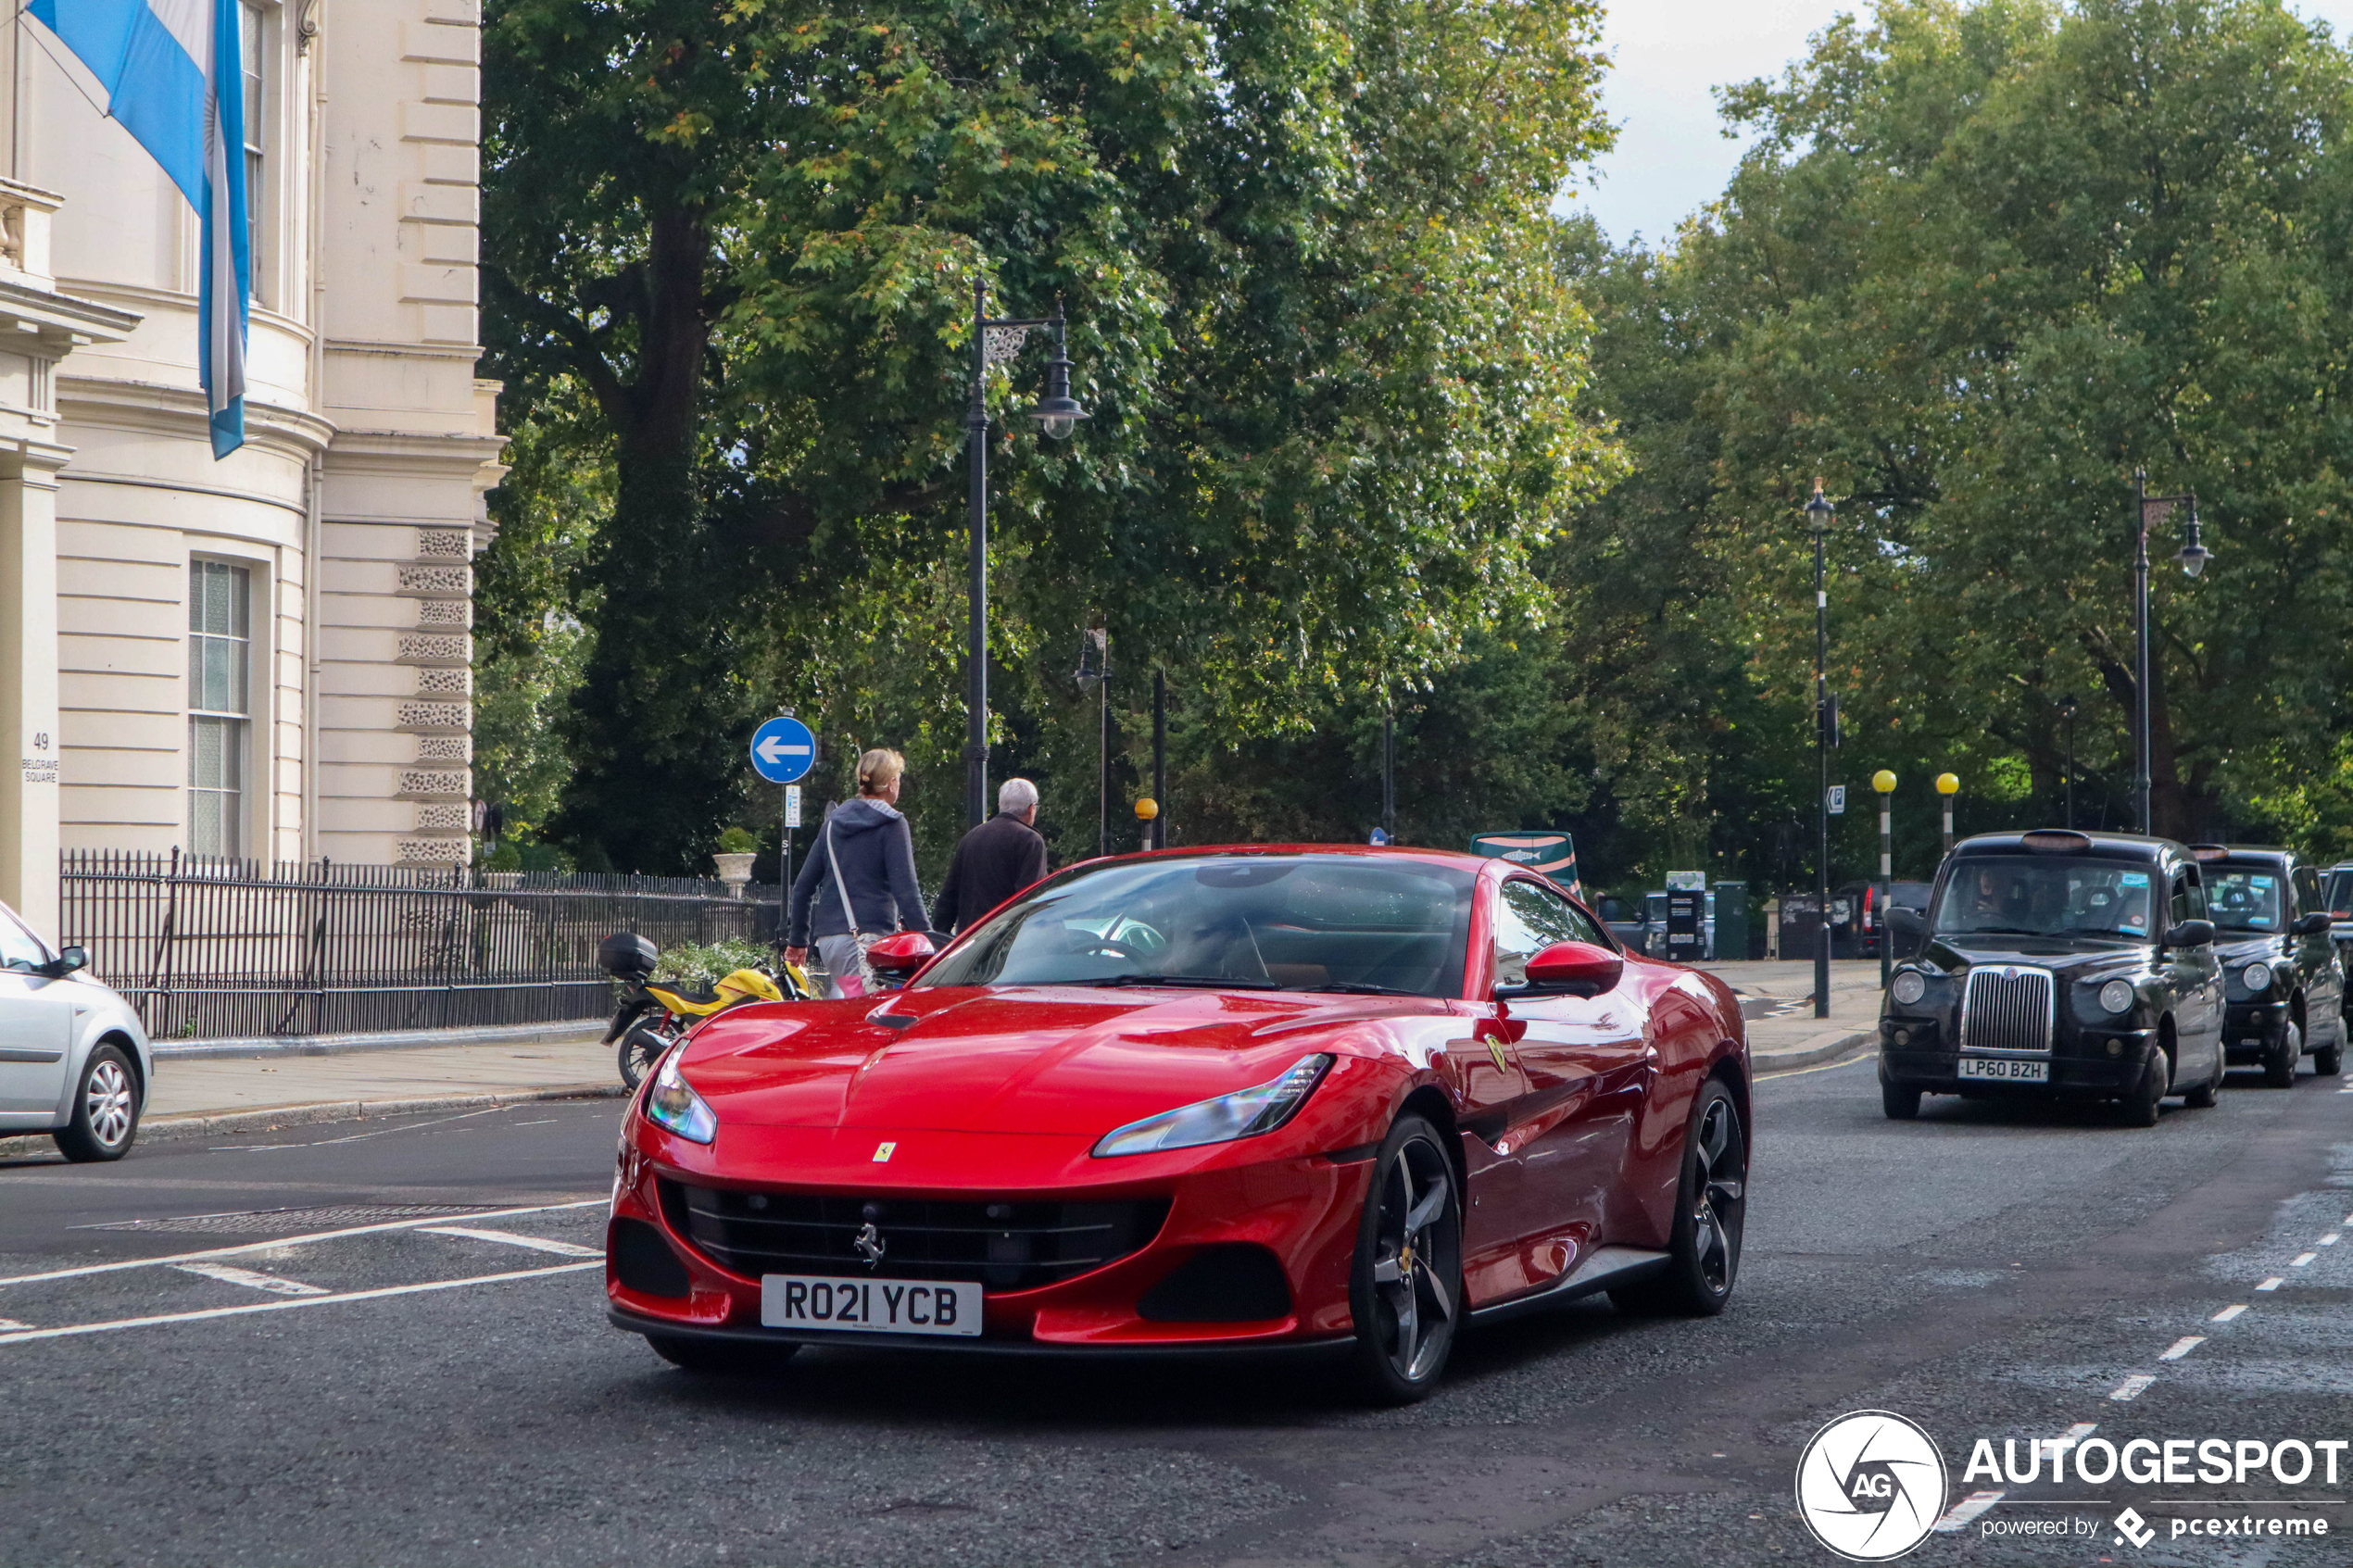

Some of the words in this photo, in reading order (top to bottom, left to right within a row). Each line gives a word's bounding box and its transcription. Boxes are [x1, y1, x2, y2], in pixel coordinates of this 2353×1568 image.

[34, 733, 48, 750] 49
[21, 759, 58, 771] BELGRAVE
[25, 771, 57, 783] SQUARE
[782, 839, 789, 848] S
[1966, 1060, 2006, 1076] LP60
[2010, 1062, 2041, 1078] BZH
[786, 1281, 869, 1322] RO21
[882, 1286, 957, 1325] YCB
